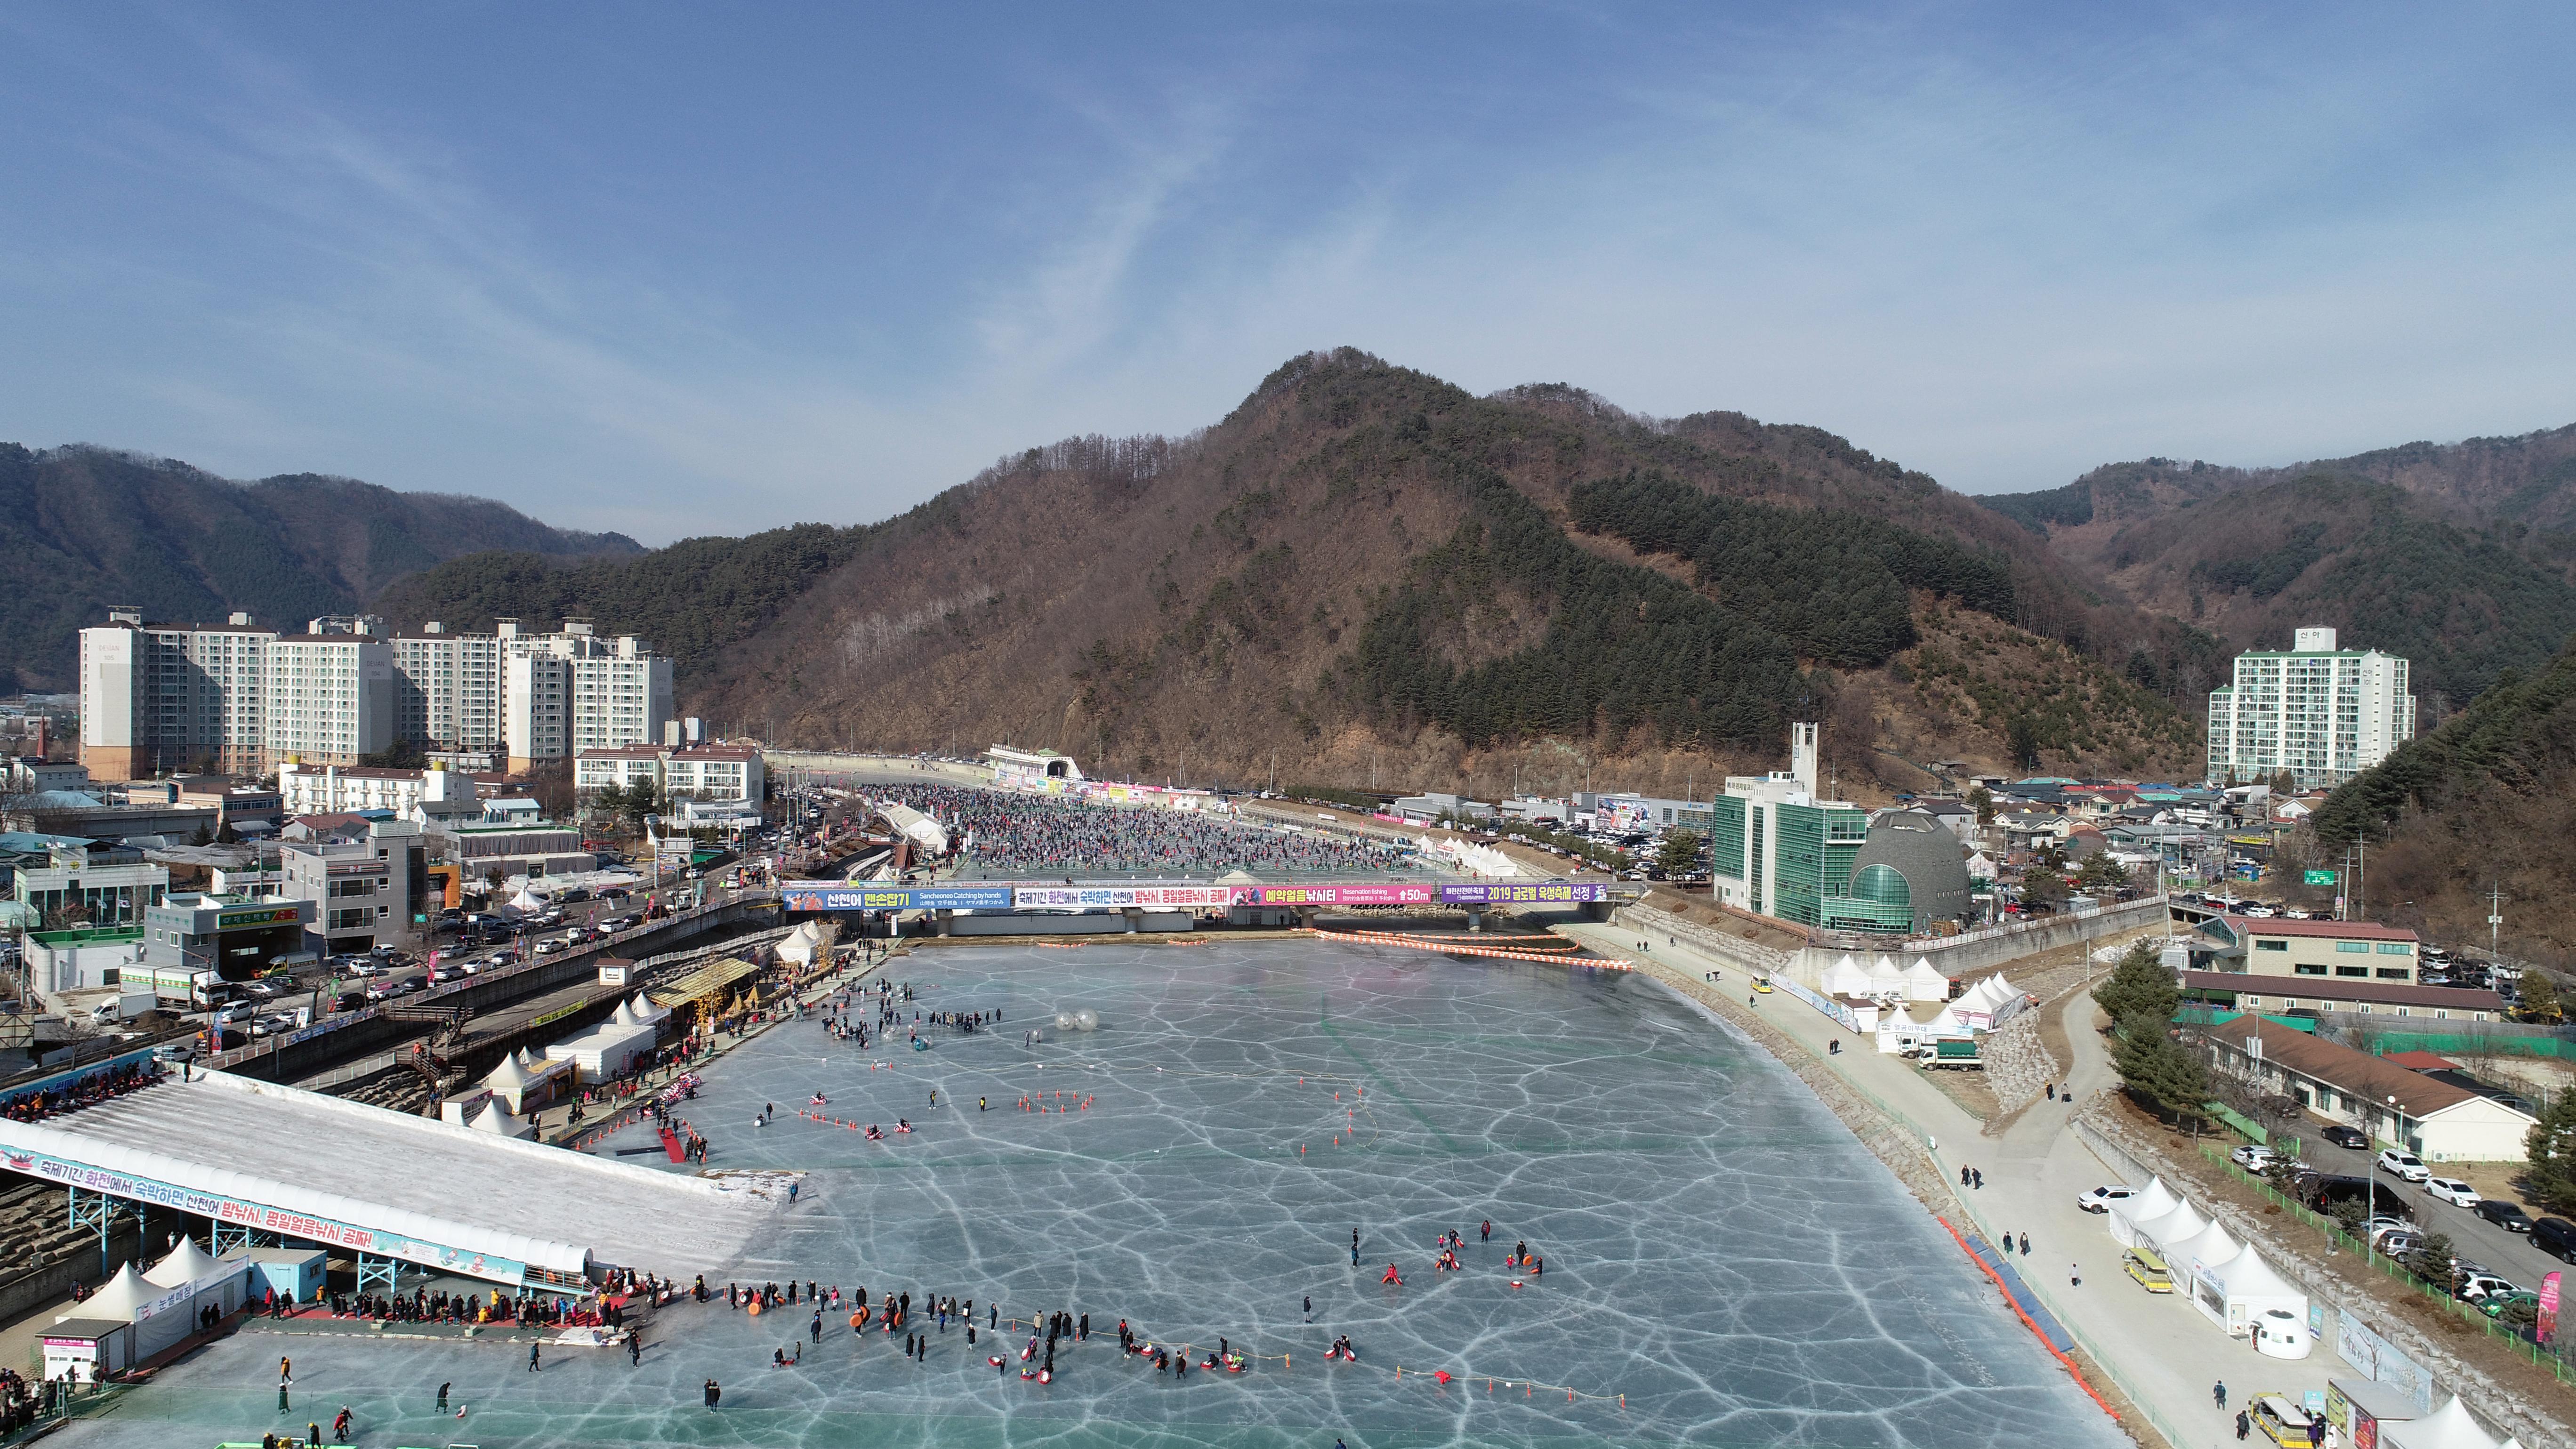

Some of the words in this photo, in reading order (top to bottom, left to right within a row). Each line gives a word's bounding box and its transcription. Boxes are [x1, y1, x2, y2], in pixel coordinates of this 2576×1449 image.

[827, 893, 861, 907] 산천어
[864, 893, 910, 907] 맨손잡기
[1019, 891, 1046, 904] 축제기간
[1049, 890, 1078, 904] 화천에서
[1080, 890, 1111, 904] 숙박하면
[1113, 891, 1133, 904] 산천어
[1135, 889, 1160, 904] 밤낚시,
[1163, 889, 1208, 903] 평일얼음낚시
[1210, 889, 1227, 903] 공짜!
[1266, 889, 1336, 902] 예약얼음낚시터
[1407, 889, 1428, 901] 50m
[1488, 887, 1511, 900] 2019
[1513, 886, 1536, 901] 글로벌
[1539, 886, 1571, 900] 육성축제
[1572, 886, 1589, 900] 선정
[1894, 1024, 1927, 1032] 얼곰이부대
[40, 1159, 83, 1183] 축제기간
[83, 1169, 133, 1194] 화천에서
[134, 1181, 185, 1206] 숙박하면
[186, 1194, 220, 1215] 산천어
[220, 1200, 262, 1224] 밤낚시,
[265, 1210, 340, 1241] 평일얼음낚시
[342, 1225, 373, 1249] 공짜!
[158, 1285, 192, 1311] 눈썰매장
